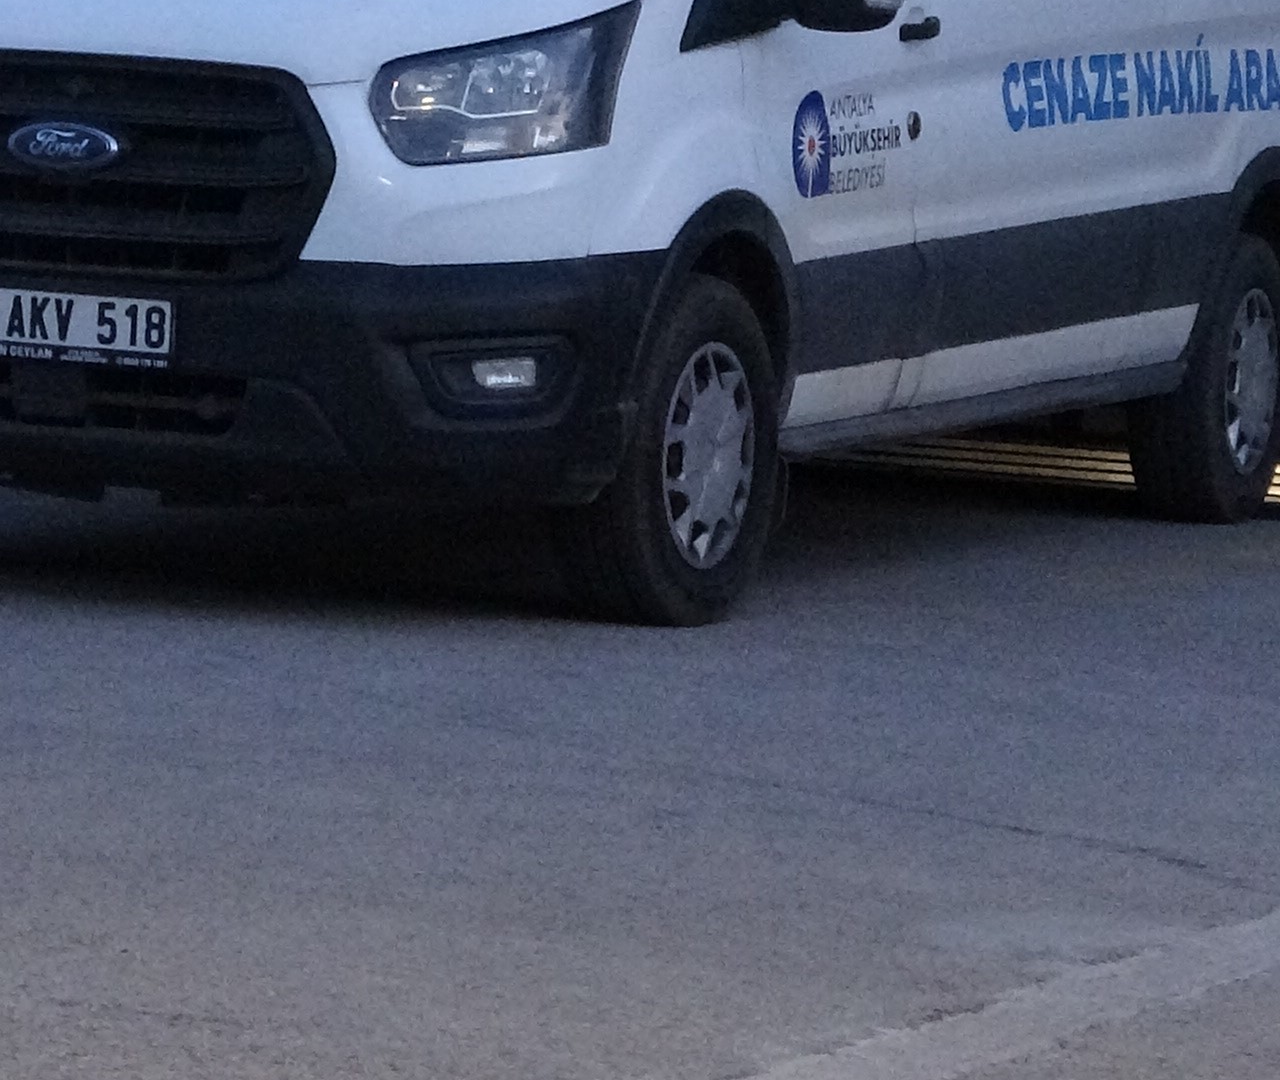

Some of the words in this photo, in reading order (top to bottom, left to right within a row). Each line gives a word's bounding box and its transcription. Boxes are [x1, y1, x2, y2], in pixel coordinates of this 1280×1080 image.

[1001, 52, 1130, 132] CENAZE
[1133, 33, 1219, 118] NAKİL
[829, 93, 875, 120] ANTALYA
[29, 129, 90, 158] Ford
[831, 119, 902, 160] BÜYÜKŞEHİR
[829, 158, 887, 195] BELEDİYESİ
[6, 295, 74, 342] AKV
[96, 301, 167, 349] 518
